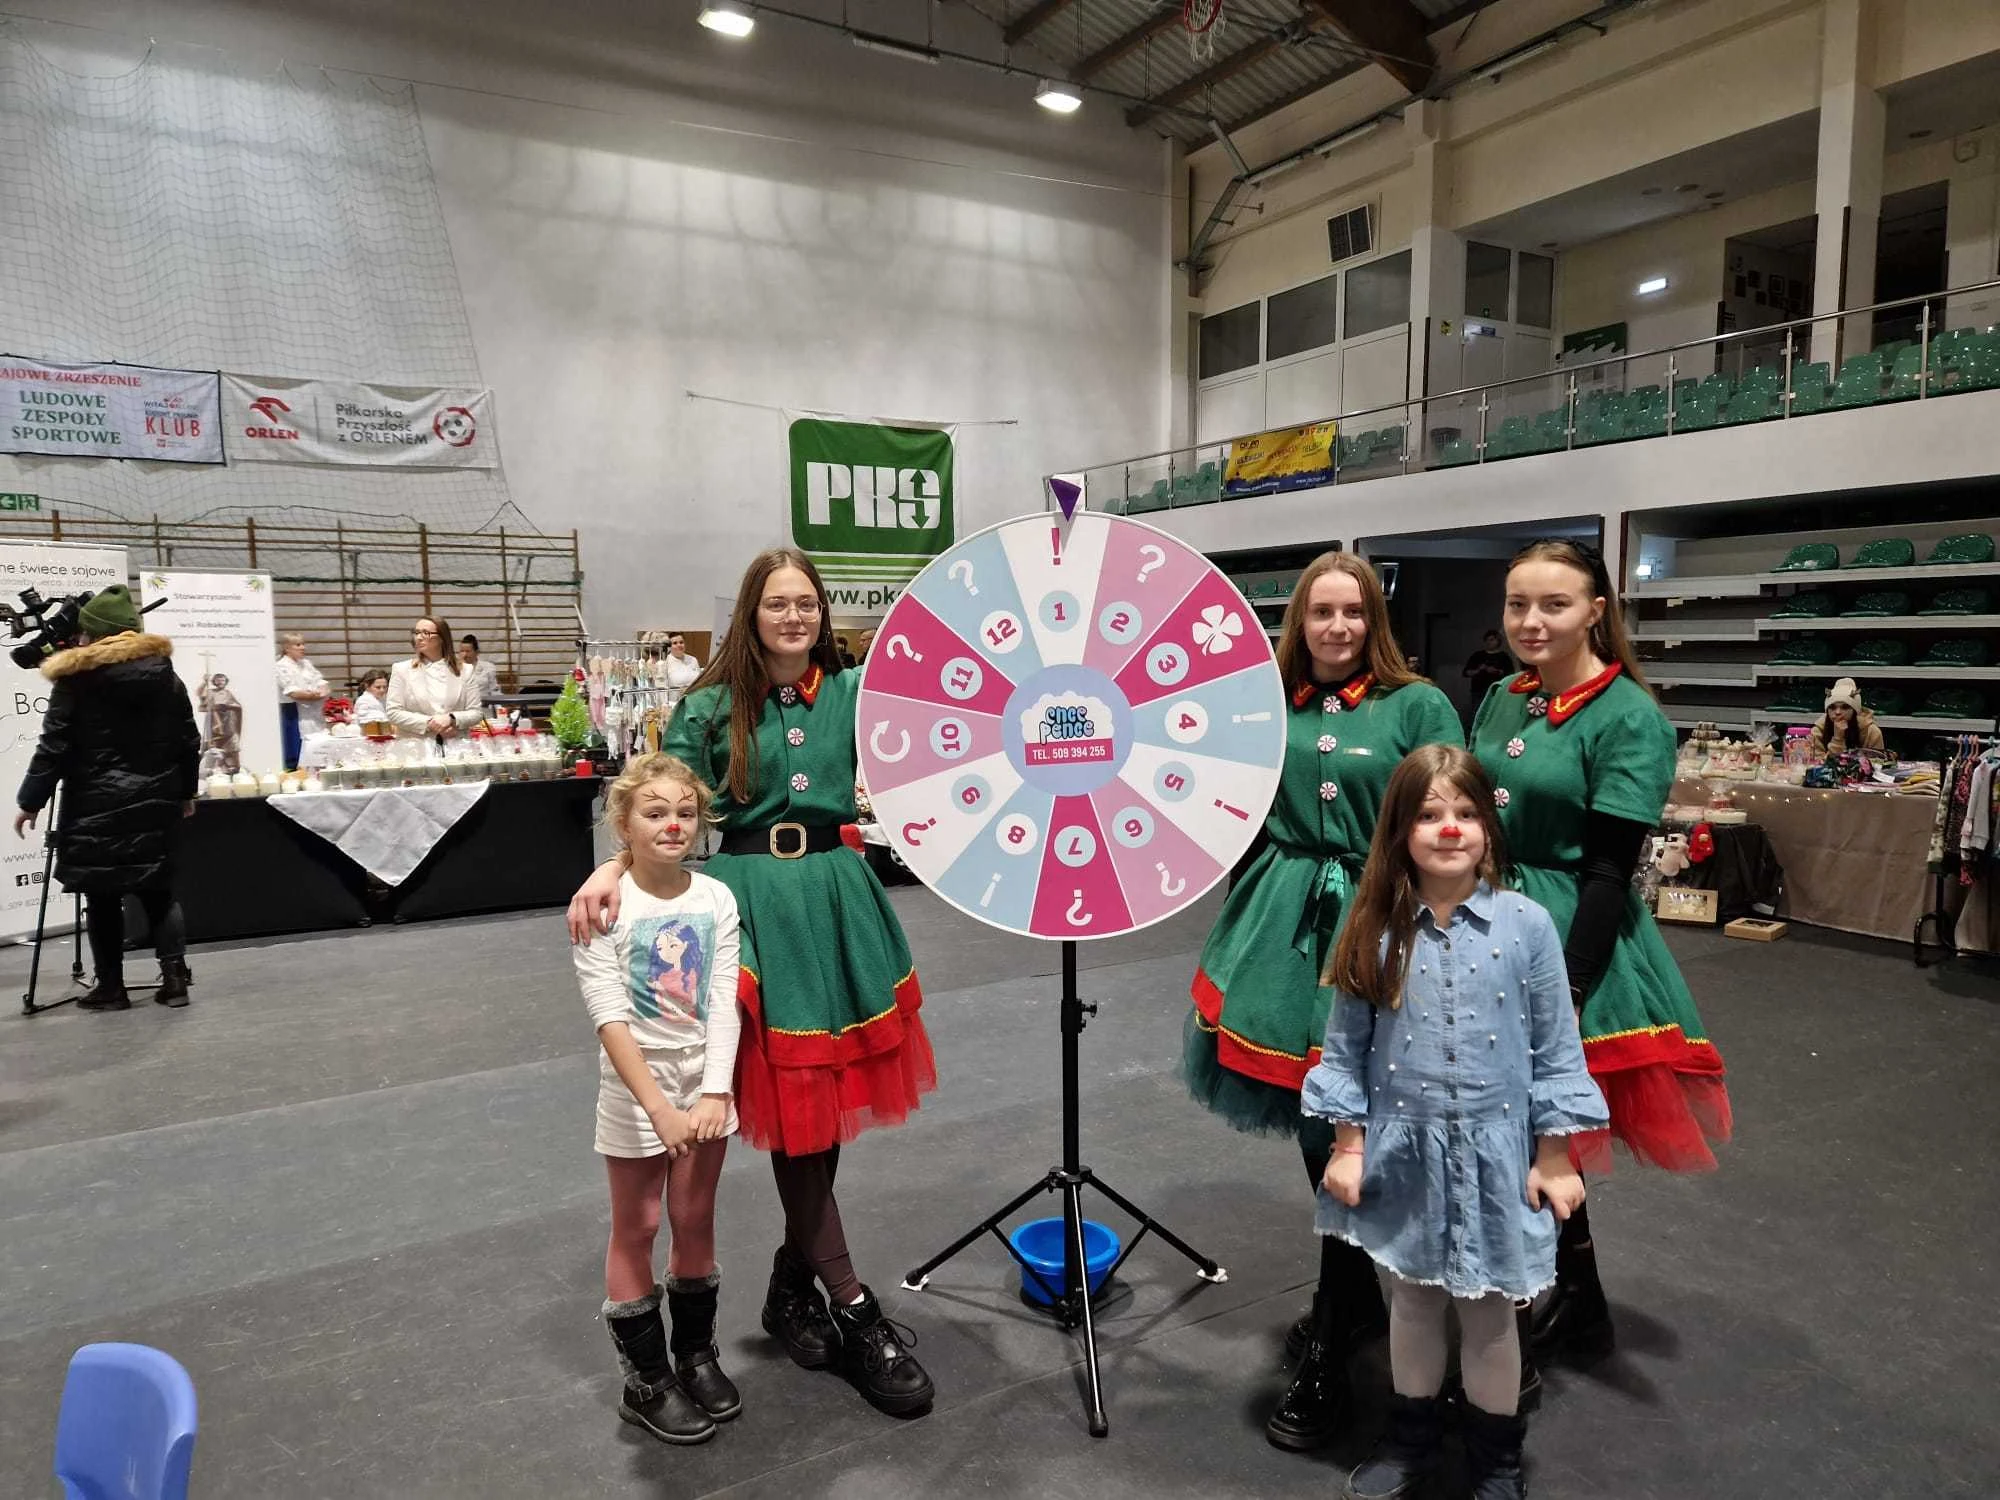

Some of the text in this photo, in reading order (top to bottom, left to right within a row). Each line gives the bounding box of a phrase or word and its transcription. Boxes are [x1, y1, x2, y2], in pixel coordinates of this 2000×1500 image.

[55, 372, 142, 387] ZRZESZENIE
[19, 390, 106, 408] LUDOWE
[22, 408, 105, 426] ZESPOŁY
[145, 416, 201, 437] KLUB
[12, 425, 121, 445] SPORTOWE
[245, 427, 298, 440] ORLEN
[338, 431, 428, 445] z ORLENEM
[806, 461, 940, 529] PKS
[71, 565, 116, 578] sojowe
[1054, 602, 1066, 621] 1
[986, 618, 1017, 646] 12
[1110, 612, 1130, 633] 2
[1158, 654, 1177, 674] 3
[950, 667, 974, 692] 11
[1178, 713, 1197, 730] 4
[941, 723, 960, 752] 10
[1033, 745, 1106, 760] TEL. 509 394 255
[1164, 773, 1185, 791] 5
[1008, 825, 1026, 844] 8
[1067, 837, 1083, 856] 7
